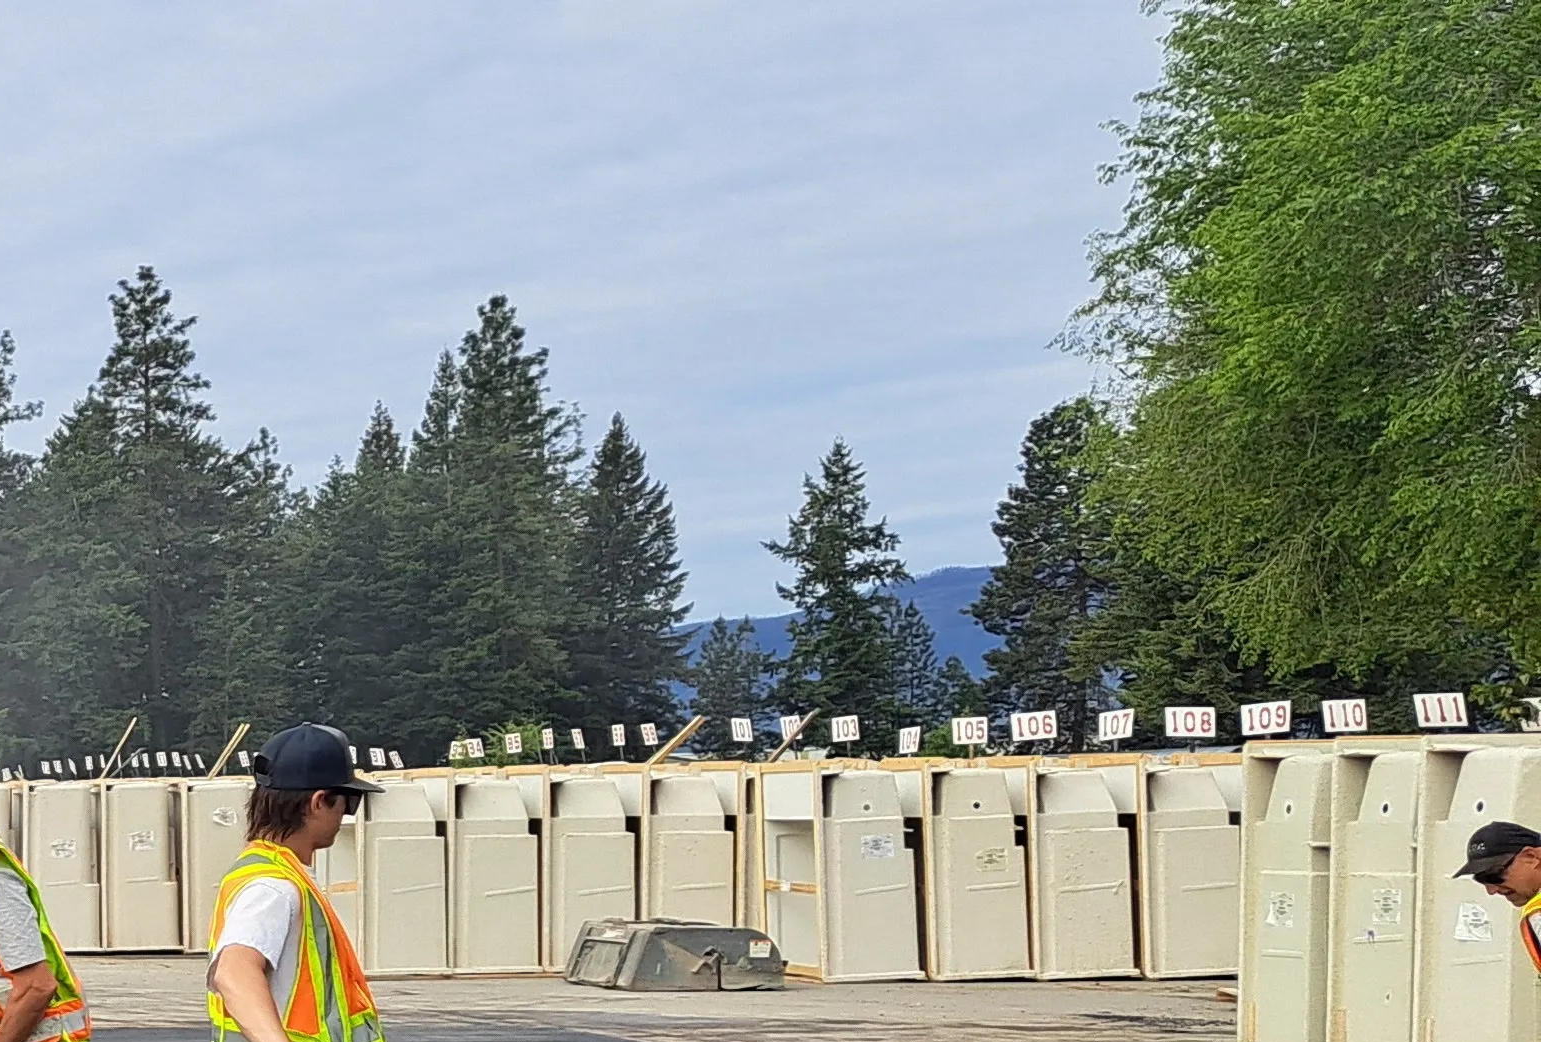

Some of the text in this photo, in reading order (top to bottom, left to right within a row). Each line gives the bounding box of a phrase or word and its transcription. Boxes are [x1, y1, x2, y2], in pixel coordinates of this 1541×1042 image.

[1248, 704, 1287, 732] 109
[1329, 702, 1364, 728] 110
[1421, 696, 1463, 723] 111
[733, 720, 752, 739] 101
[835, 718, 859, 739] 103
[957, 720, 985, 742] 105
[1017, 714, 1054, 738] 106
[1103, 712, 1132, 738] 107
[1172, 710, 1212, 734] 108
[901, 729, 918, 750] 104
